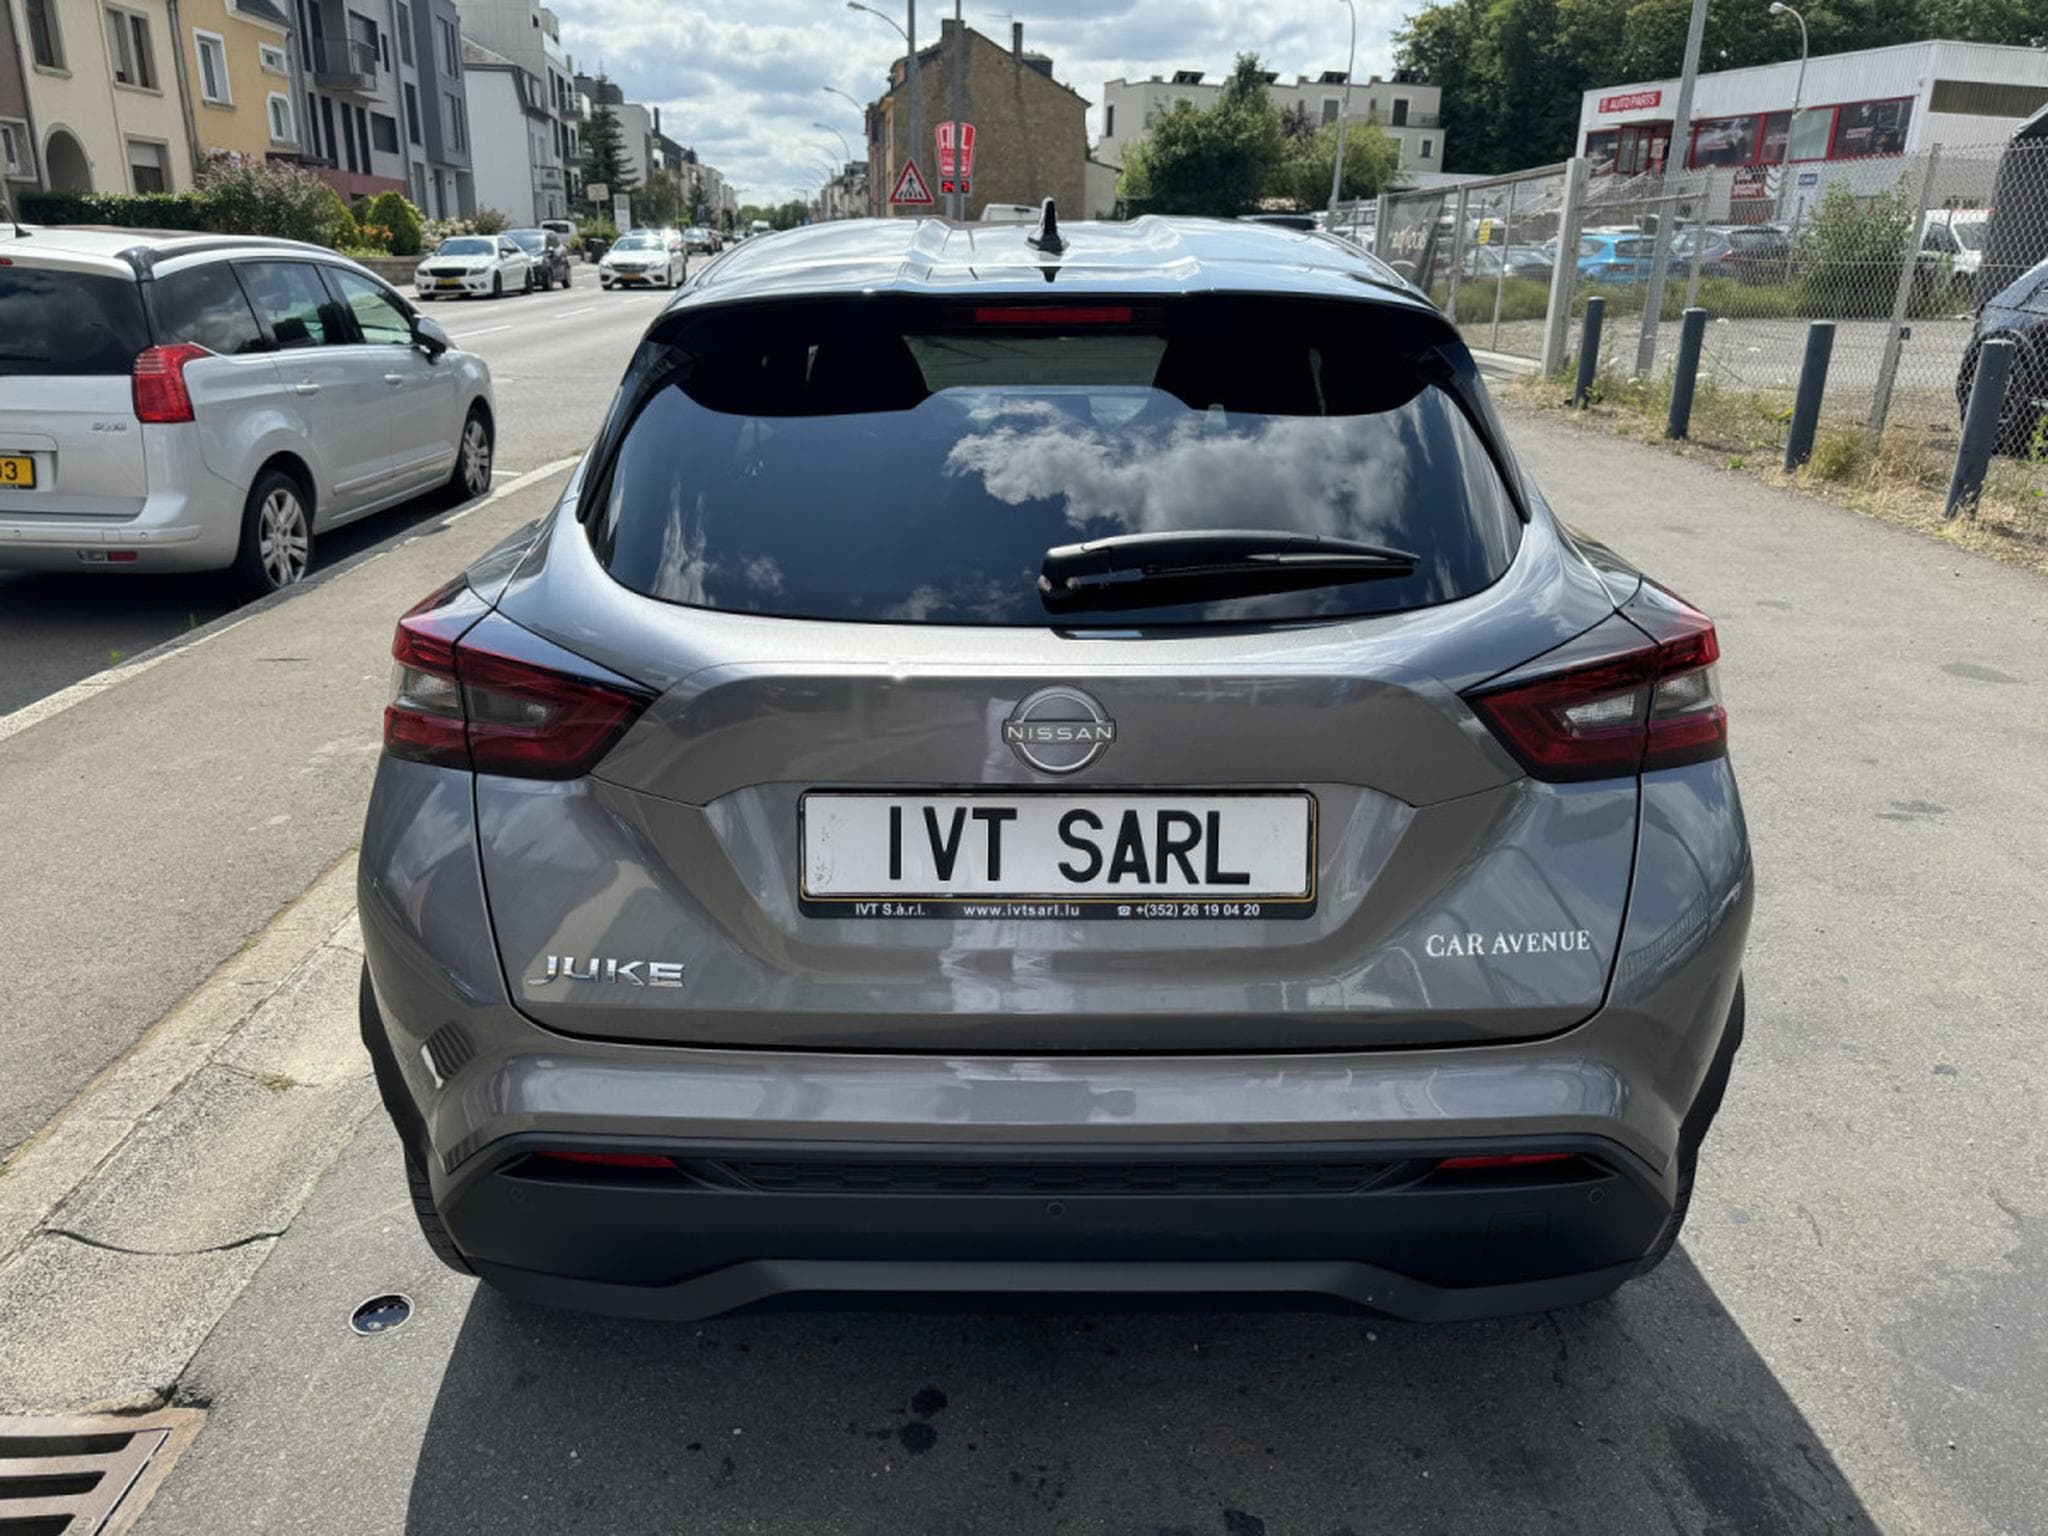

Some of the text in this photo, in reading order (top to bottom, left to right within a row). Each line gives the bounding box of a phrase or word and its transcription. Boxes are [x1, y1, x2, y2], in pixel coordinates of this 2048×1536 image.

[1007, 726, 1112, 740] NISSAN
[889, 806, 1250, 884] IVT SARL
[855, 903, 878, 916] IVT
[963, 903, 1080, 917] www.ivtsarl.lu
[1136, 903, 1260, 918] +(352) 26 19 04 20
[1425, 930, 1591, 957] CAR AVENUE
[526, 955, 684, 988] JUKE
